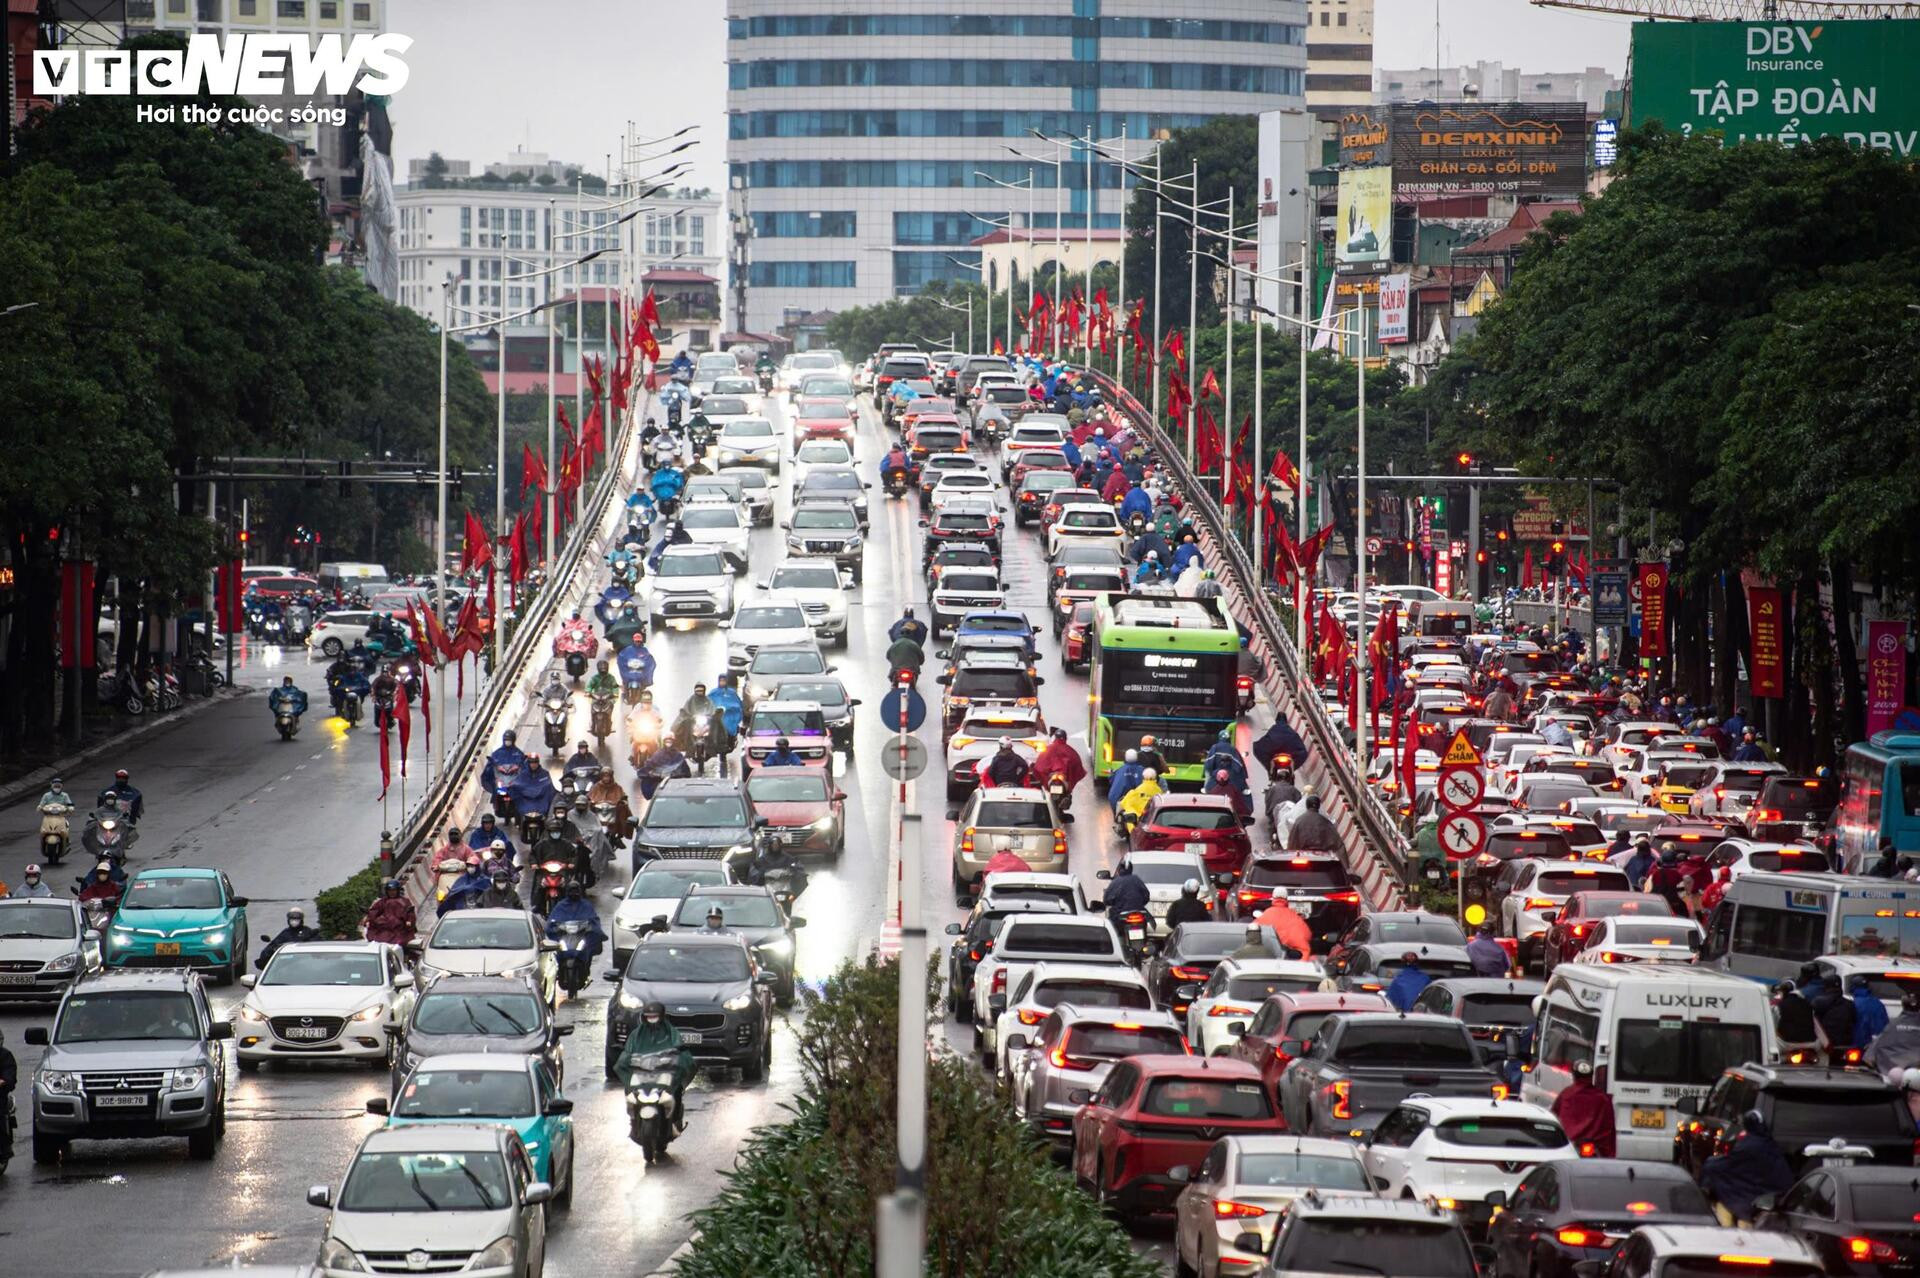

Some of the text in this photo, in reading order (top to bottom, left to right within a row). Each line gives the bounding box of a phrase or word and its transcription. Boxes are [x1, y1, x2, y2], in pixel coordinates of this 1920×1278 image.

[1746, 26, 1823, 55] DBV
[1746, 58, 1824, 71] Insurance
[1690, 80, 1759, 123] TẬP
[1772, 78, 1876, 114] ĐOÀN
[1420, 132, 1559, 145] DEMXINH
[1471, 182, 1494, 191] 1800
[1646, 993, 1732, 1009] LUXURY
